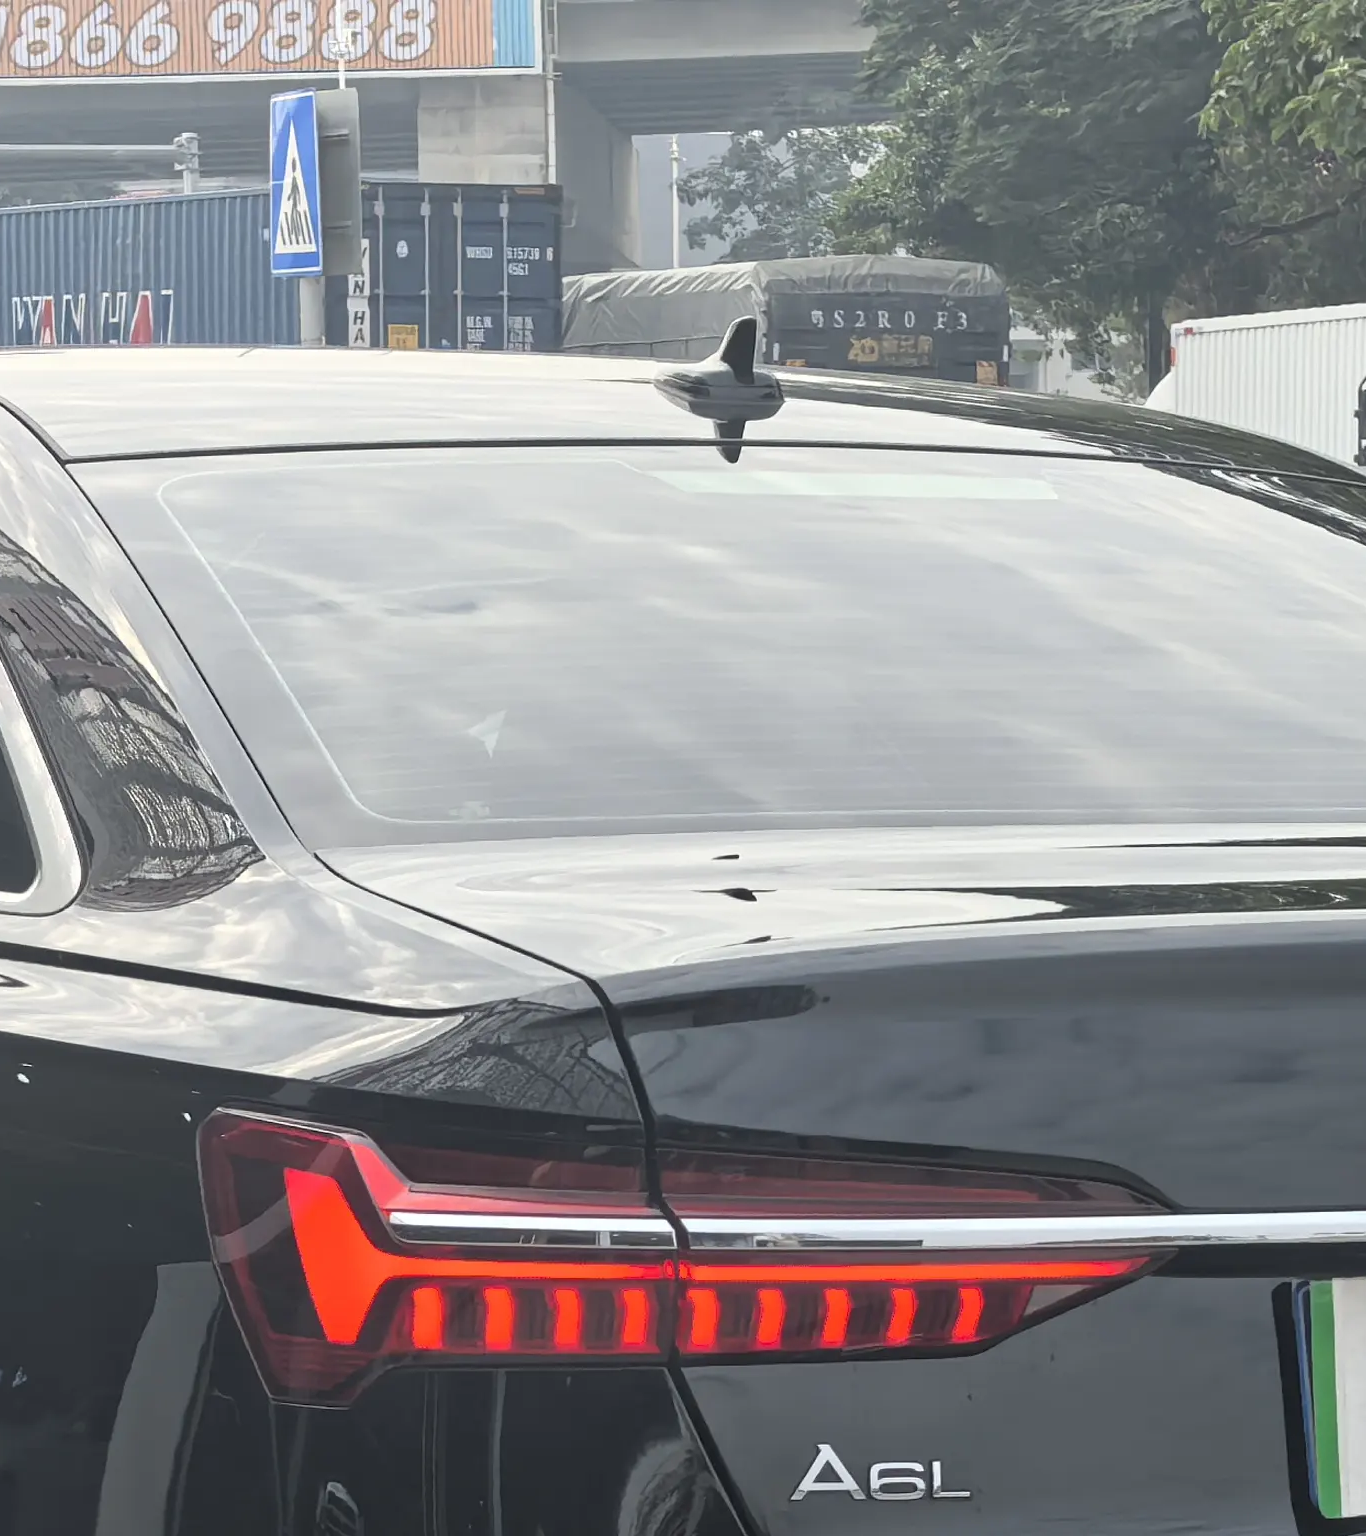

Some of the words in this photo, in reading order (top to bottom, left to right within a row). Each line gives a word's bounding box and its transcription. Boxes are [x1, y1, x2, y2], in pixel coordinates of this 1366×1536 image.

[207, 0, 436, 67] 9888
[12, 293, 86, 346] WAN
[101, 289, 174, 345] HAI
[790, 1443, 971, 1501] A6L
